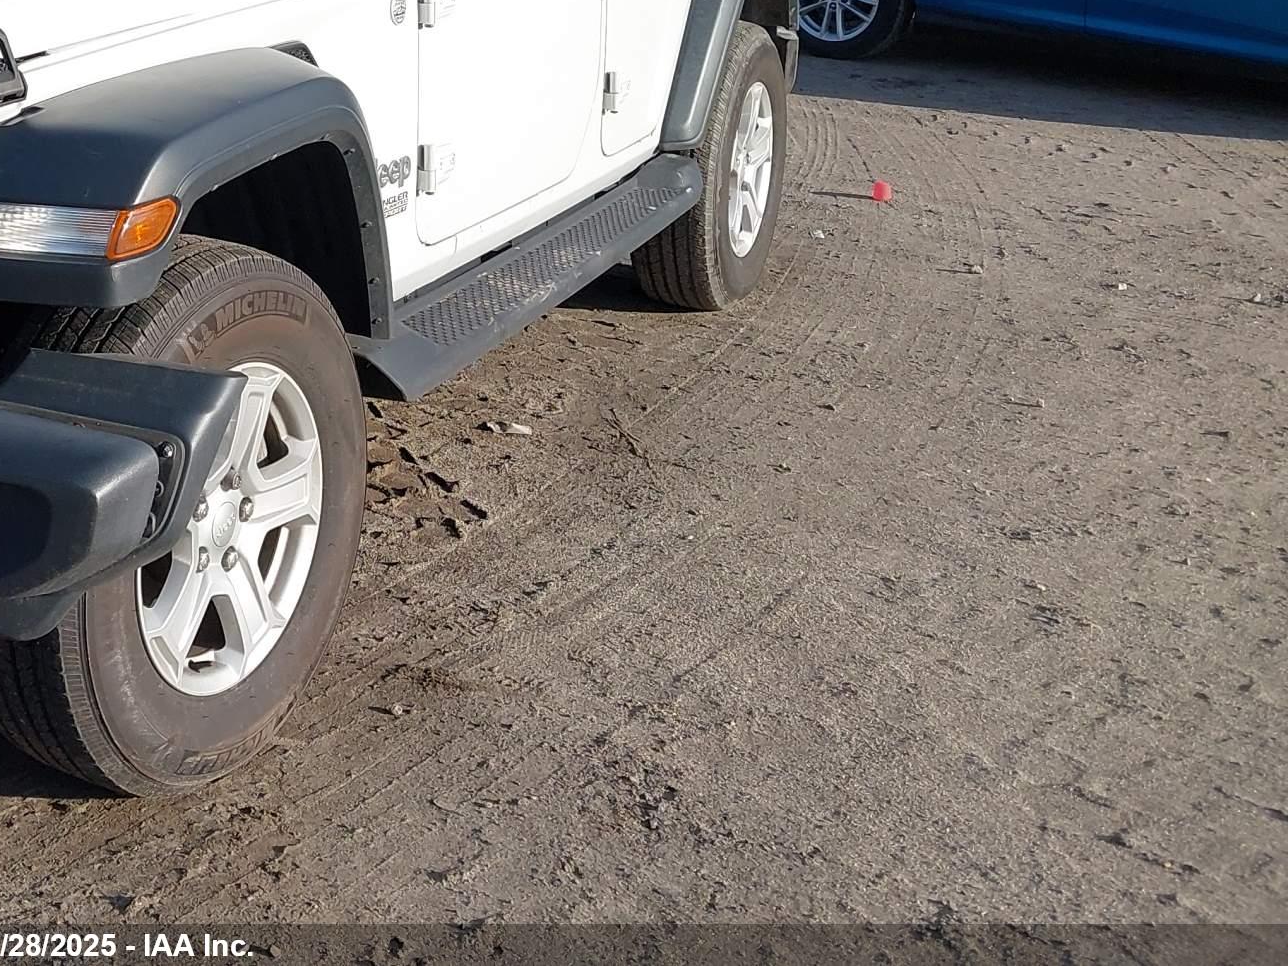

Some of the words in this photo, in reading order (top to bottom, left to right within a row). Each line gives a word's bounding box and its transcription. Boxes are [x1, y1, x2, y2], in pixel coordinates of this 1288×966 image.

[376, 155, 412, 188] eep
[383, 191, 409, 206] NGLER
[215, 291, 307, 332] MICHELIN
